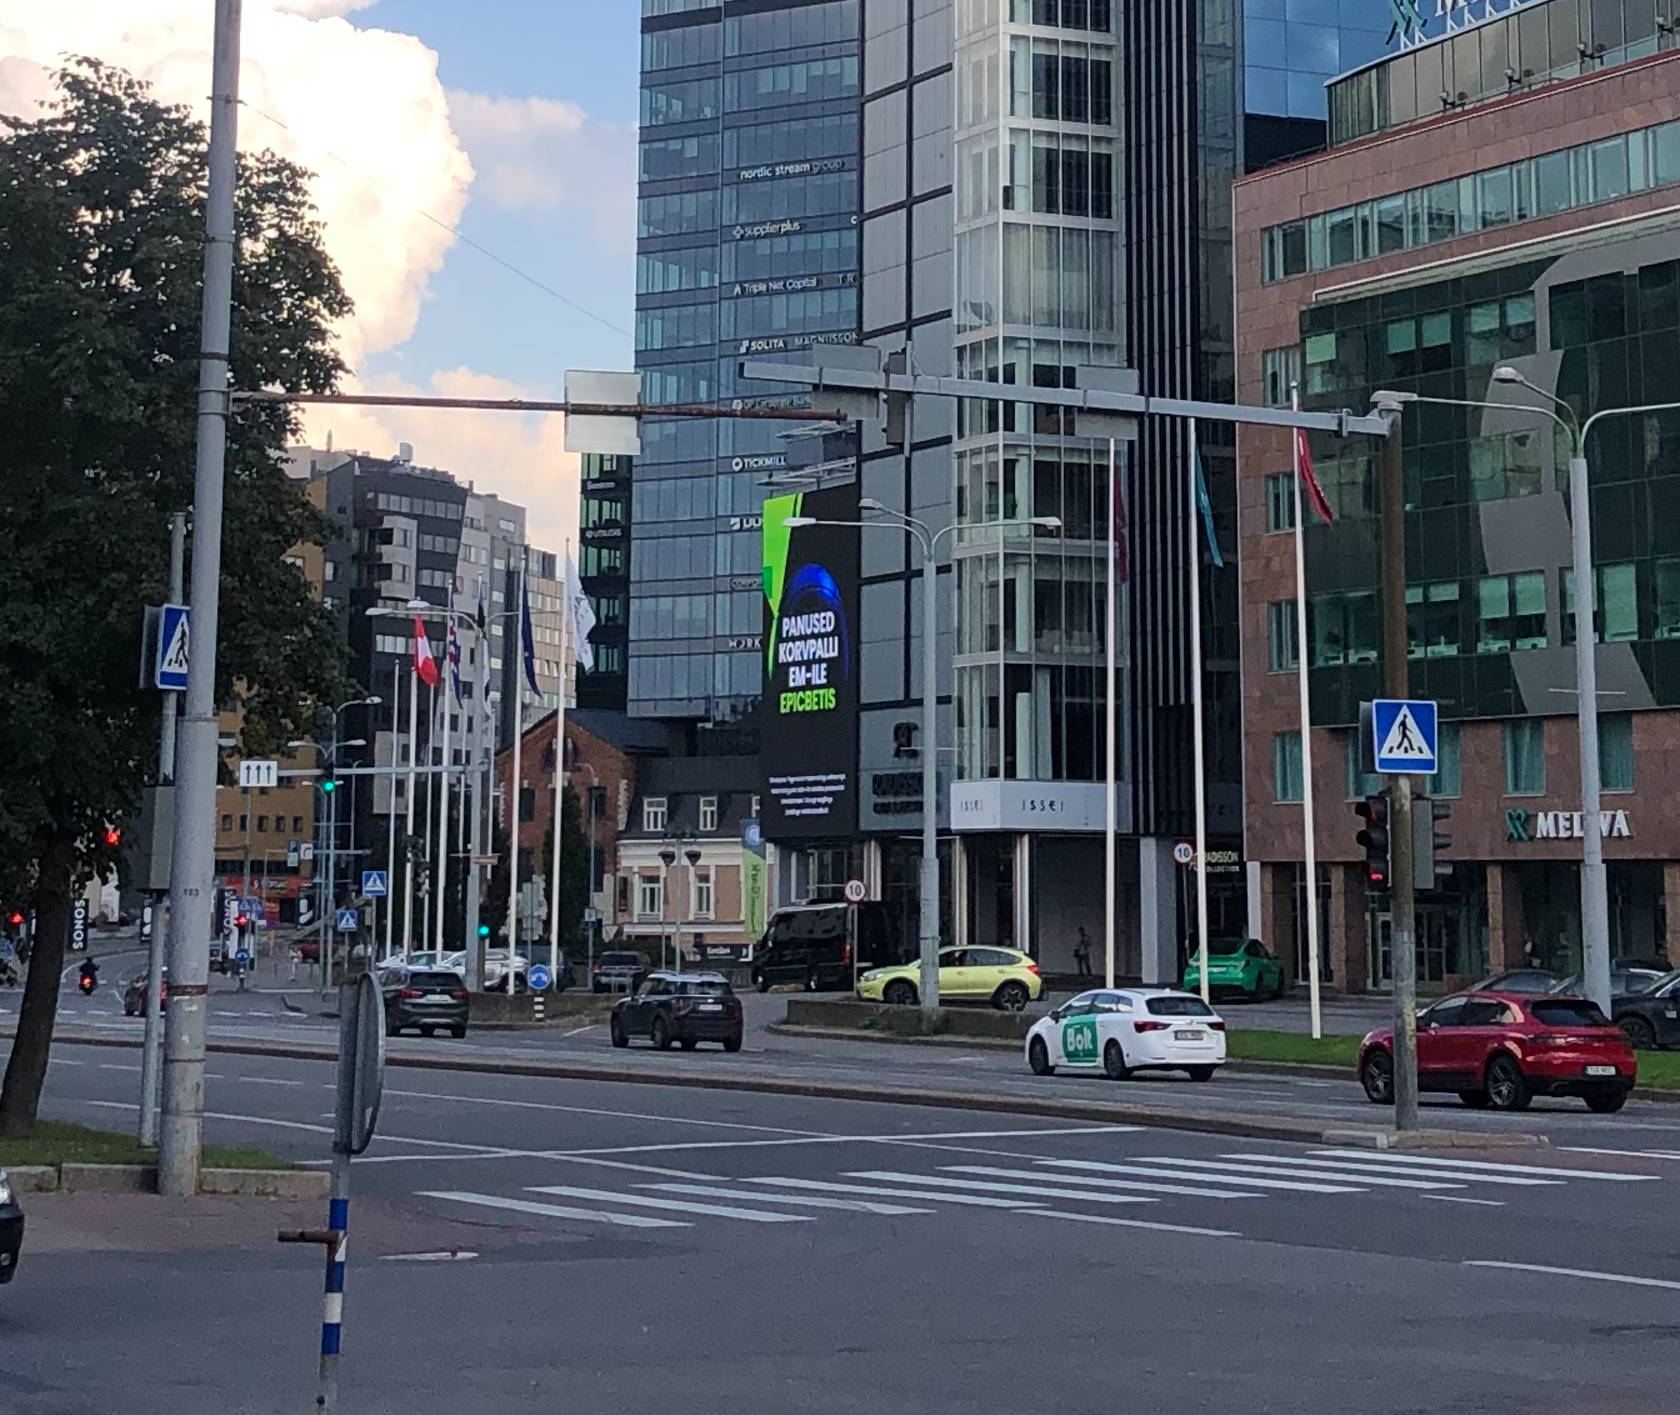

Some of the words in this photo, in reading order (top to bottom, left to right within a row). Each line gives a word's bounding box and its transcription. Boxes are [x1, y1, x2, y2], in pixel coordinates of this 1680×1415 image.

[740, 167, 772, 180] nordic
[775, 163, 810, 176] stream
[745, 220, 800, 237] supplierplus
[750, 339, 785, 351] SOLITA
[744, 455, 787, 469] TICKMILL
[782, 611, 835, 637] PANUSED
[778, 636, 839, 663] KORVPALLI
[788, 663, 828, 687] EM-ILE
[780, 688, 837, 714] EPICBETIS
[1536, 810, 1632, 838] MELVA
[1178, 847, 1190, 859] 10
[1204, 851, 1239, 863] ADISSON
[849, 884, 862, 897] 10
[72, 899, 86, 950] SONOS
[1067, 1026, 1093, 1052] Bolt
